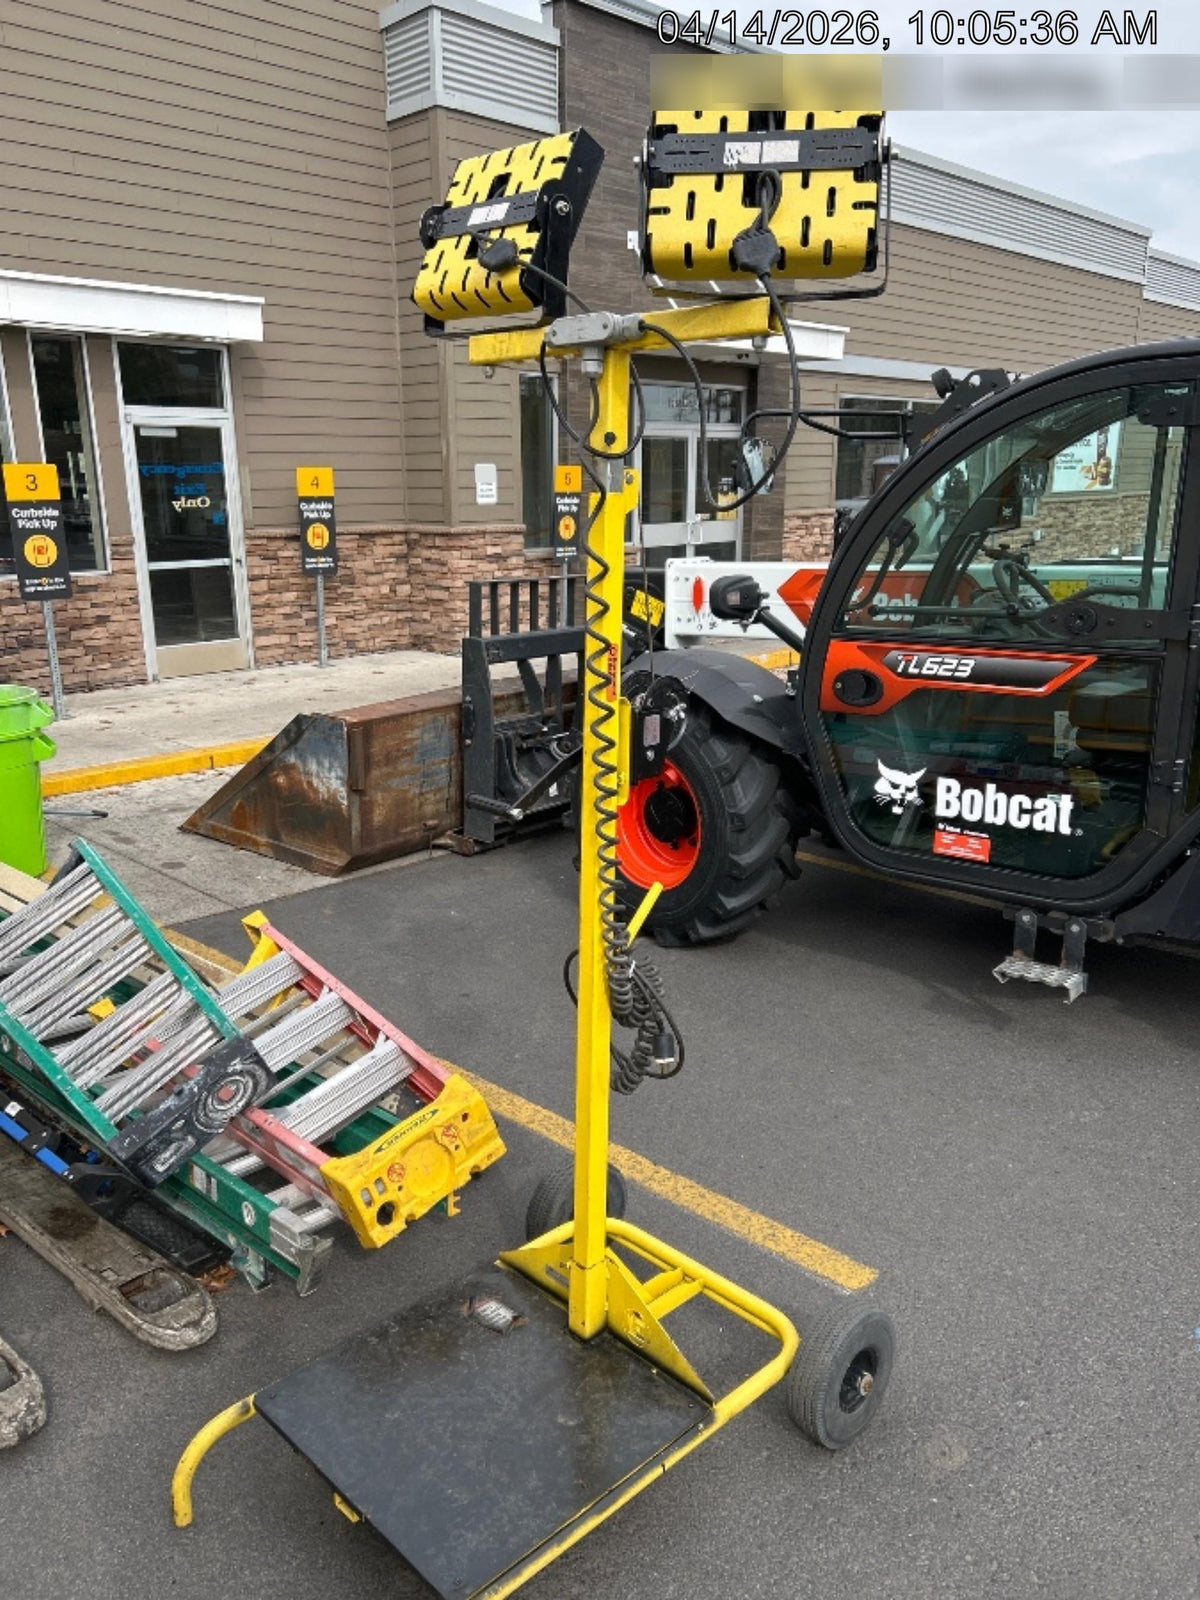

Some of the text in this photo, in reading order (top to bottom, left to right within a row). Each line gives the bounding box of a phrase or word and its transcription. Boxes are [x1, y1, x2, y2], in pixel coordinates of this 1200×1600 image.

[25, 473, 38, 491] 3
[310, 476, 319, 489] 4
[564, 472, 572, 486] 5
[11, 507, 60, 519] Curbside
[17, 518, 58, 531] Pick Up
[897, 653, 976, 678] TL623
[934, 776, 1075, 836] Bobcat
